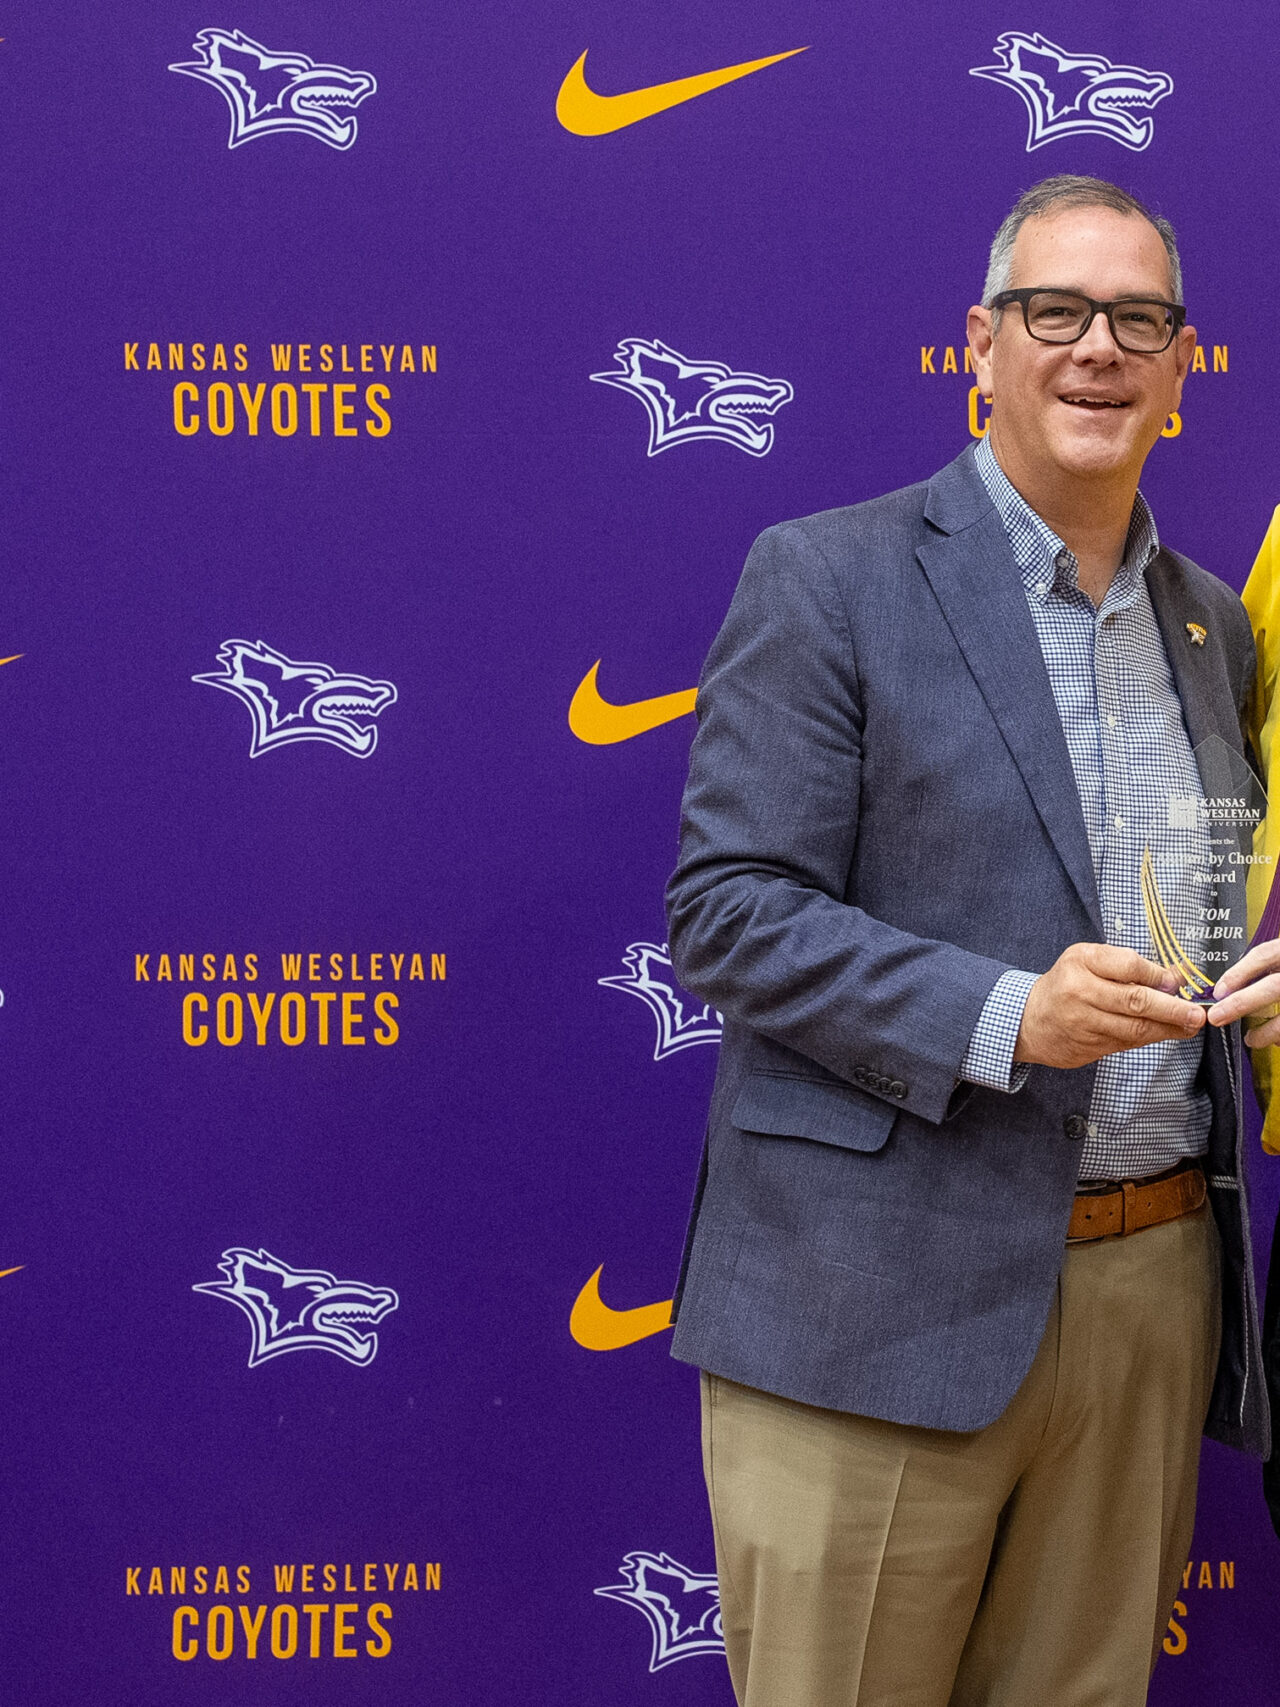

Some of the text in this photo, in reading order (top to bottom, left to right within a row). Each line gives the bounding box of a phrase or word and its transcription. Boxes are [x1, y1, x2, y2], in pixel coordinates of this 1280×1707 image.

[125, 343, 437, 372] KANSAS WESLEYAN
[921, 346, 976, 374] KAN
[173, 381, 392, 438] COYOTES
[1200, 797, 1246, 808] KANSAS
[1201, 808, 1260, 818] WESLEYAN
[1209, 851, 1225, 867] by
[1228, 851, 1272, 865] Choice
[1193, 870, 1236, 883] Award
[1199, 908, 1231, 921] TOM
[1185, 926, 1243, 939] WILBUR
[135, 953, 446, 981] KANSAS WESLEYAN
[1200, 951, 1229, 962] 2025
[182, 991, 399, 1047] COYOTES
[126, 1563, 441, 1595] KANSAS WESLEYAN
[172, 1602, 393, 1661] COYOTES
